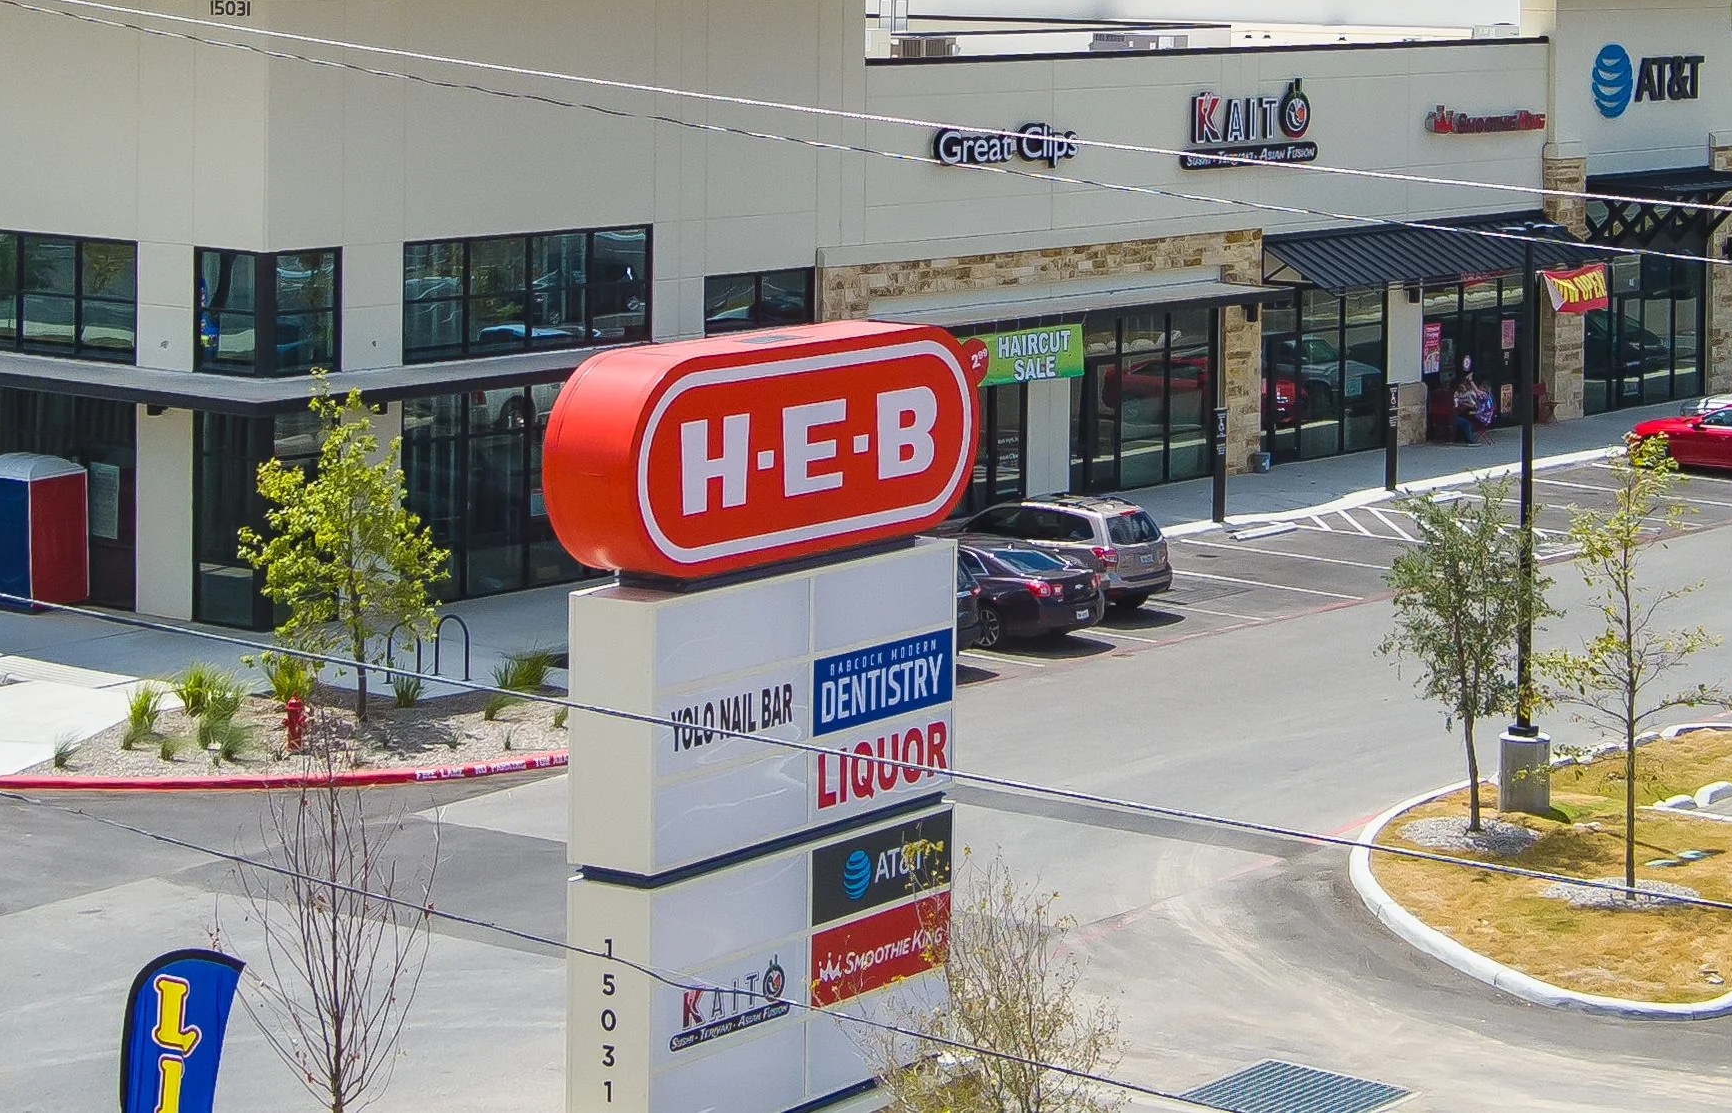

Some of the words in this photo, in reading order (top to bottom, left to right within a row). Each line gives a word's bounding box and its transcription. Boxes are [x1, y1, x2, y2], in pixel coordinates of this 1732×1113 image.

[210, 0, 251, 17] 15031
[1635, 55, 1705, 103] AT&T
[938, 129, 1013, 164] Great
[1021, 124, 1079, 168] Clips
[998, 330, 1071, 358] HAIRCUT
[1014, 356, 1057, 381] SALE
[830, 657, 882, 676] BABCOCK
[891, 639, 937, 662] MODERN
[821, 653, 944, 724] DENTISTRY
[670, 702, 715, 753] YOLO
[720, 693, 757, 741] NAIL
[761, 683, 793, 729] BAR
[817, 721, 948, 810] LIQUOR
[844, 937, 912, 975] SMOOTHIE
[911, 927, 944, 953] KING
